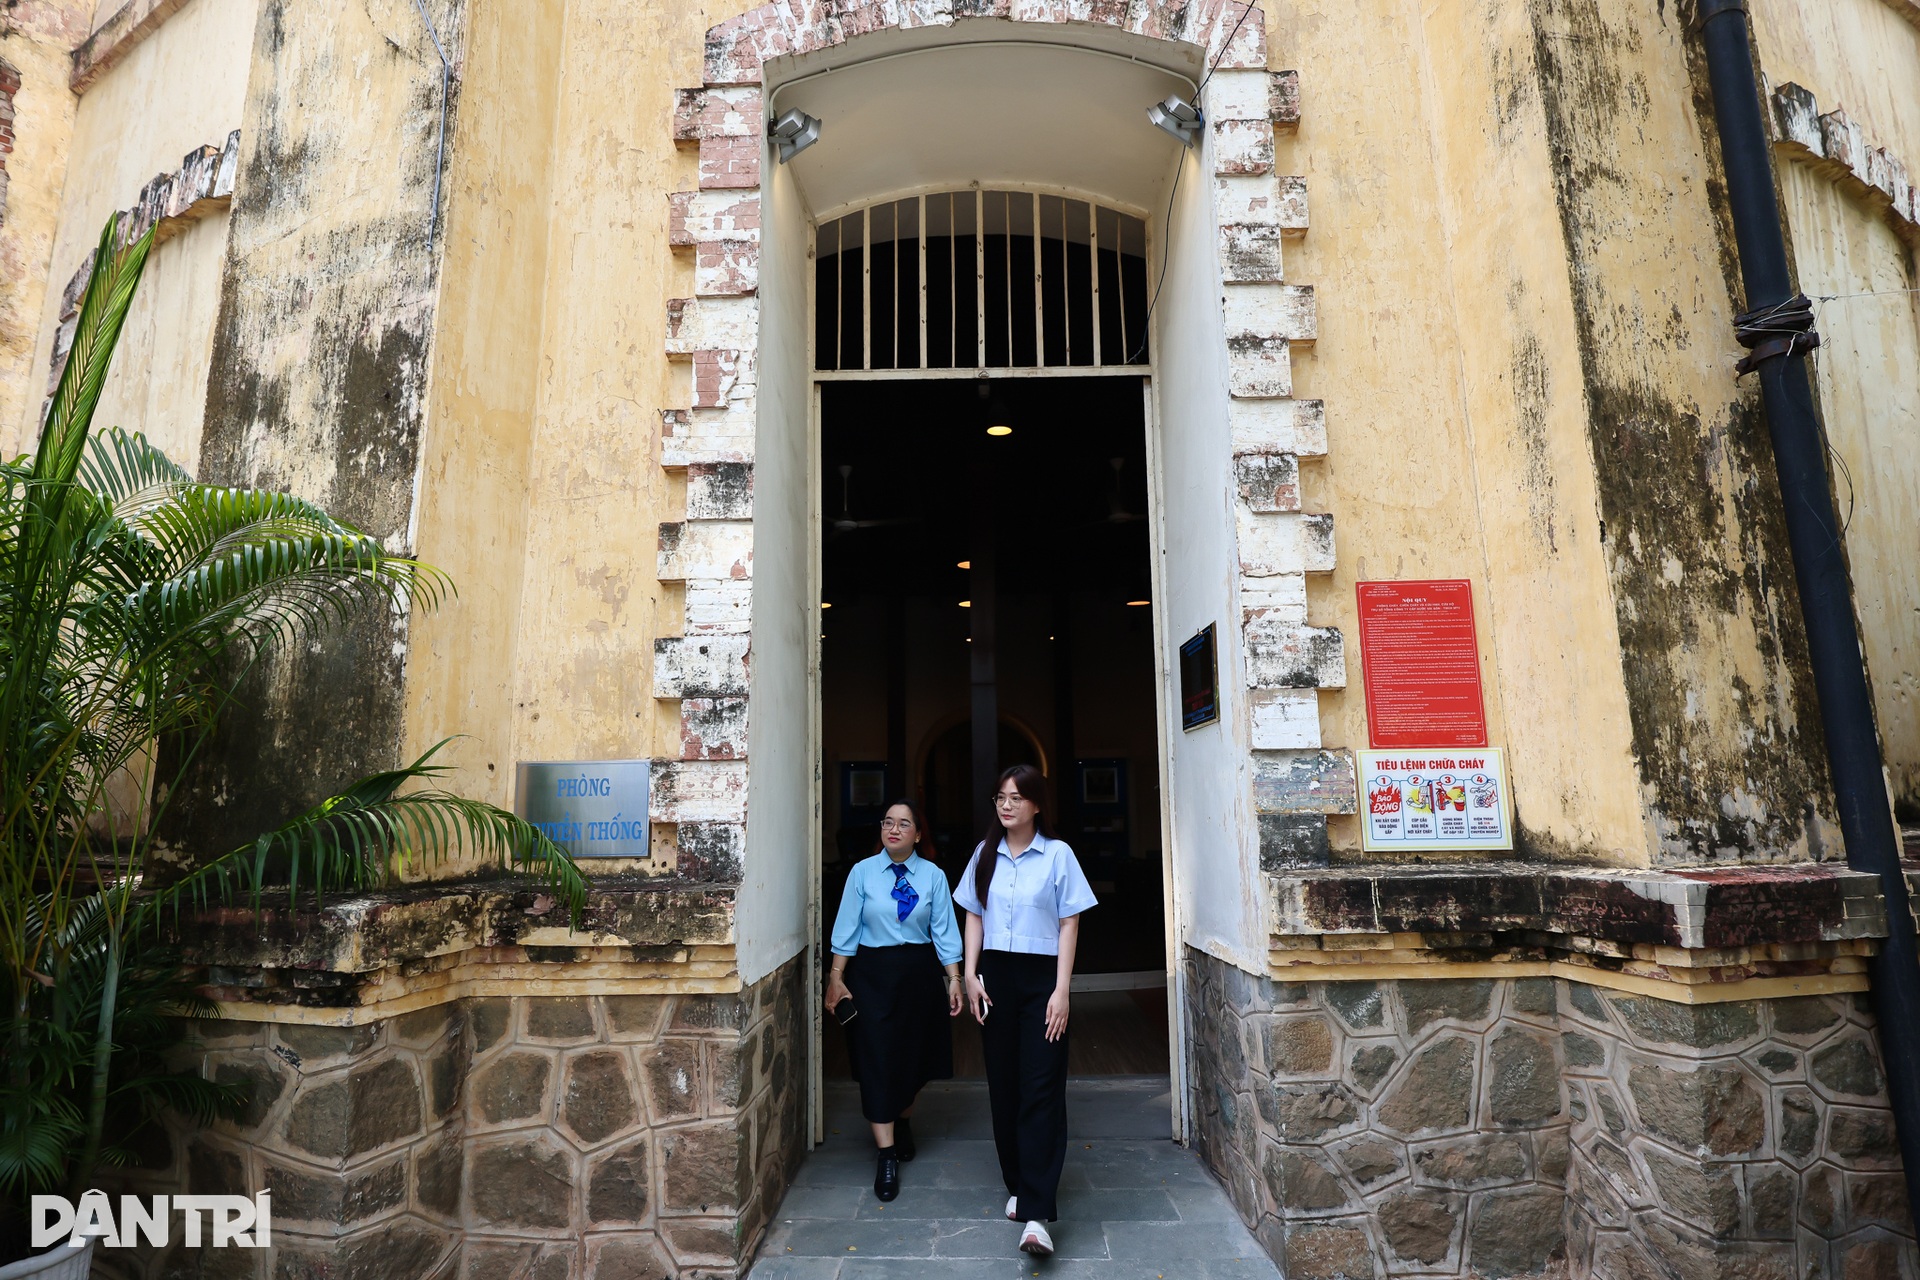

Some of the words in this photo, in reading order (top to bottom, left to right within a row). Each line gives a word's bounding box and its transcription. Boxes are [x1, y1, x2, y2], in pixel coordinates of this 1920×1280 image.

[1376, 758, 1397, 770] TIÊU
[1401, 758, 1426, 772] LỆNH
[1429, 758, 1456, 770] CHỮA
[1459, 758, 1485, 769] CHÁY
[557, 773, 611, 797] PHÒNG
[1377, 794, 1392, 802] BÁO
[1374, 802, 1398, 812] ĐỘNG
[588, 812, 643, 840] THỐNG
